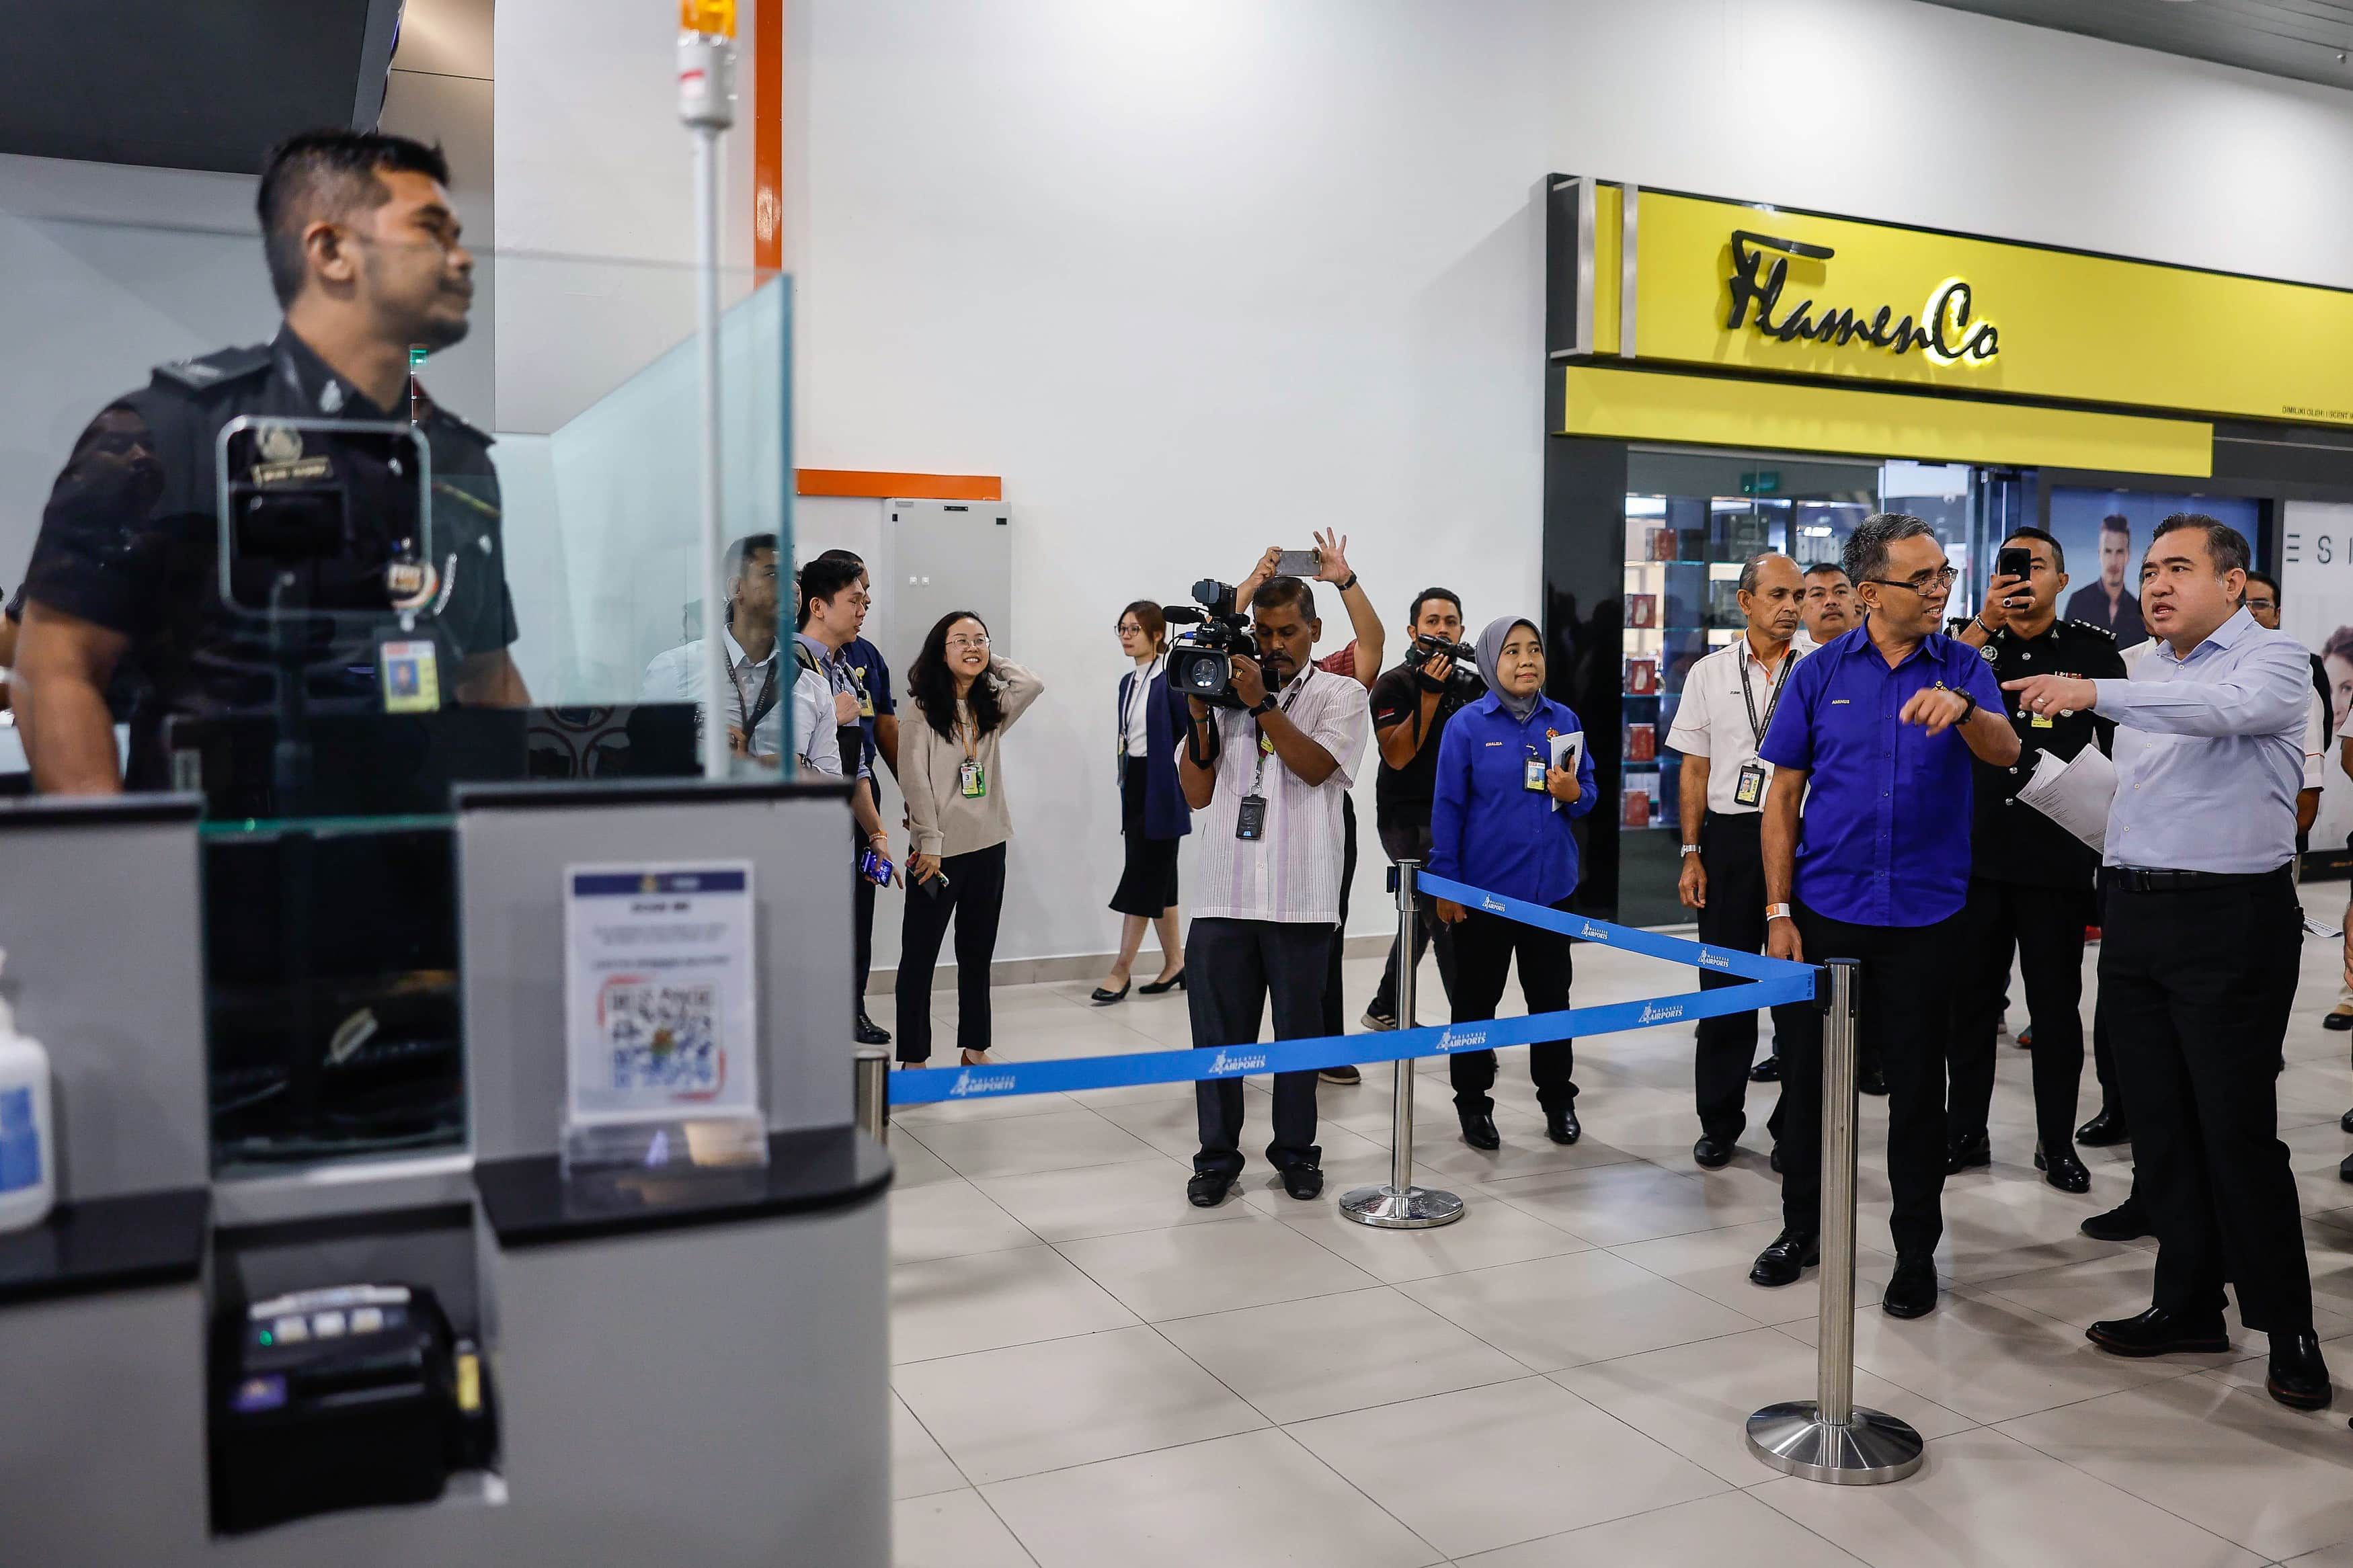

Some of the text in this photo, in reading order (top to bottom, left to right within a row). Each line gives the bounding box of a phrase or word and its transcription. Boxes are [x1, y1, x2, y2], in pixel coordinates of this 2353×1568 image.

[2286, 534, 2353, 565] ES
[1588, 930, 1608, 940] AIRPORTS
[1706, 958, 1729, 968] AIRPORTS
[1652, 1005, 1683, 1013] MALAYSIA
[1650, 1009, 1683, 1020] AIRPORTS
[1452, 1032, 1486, 1040] MALAYSIA
[1450, 1036, 1486, 1047] AIRPORTS
[1224, 1060, 1266, 1071] AIRPORTS
